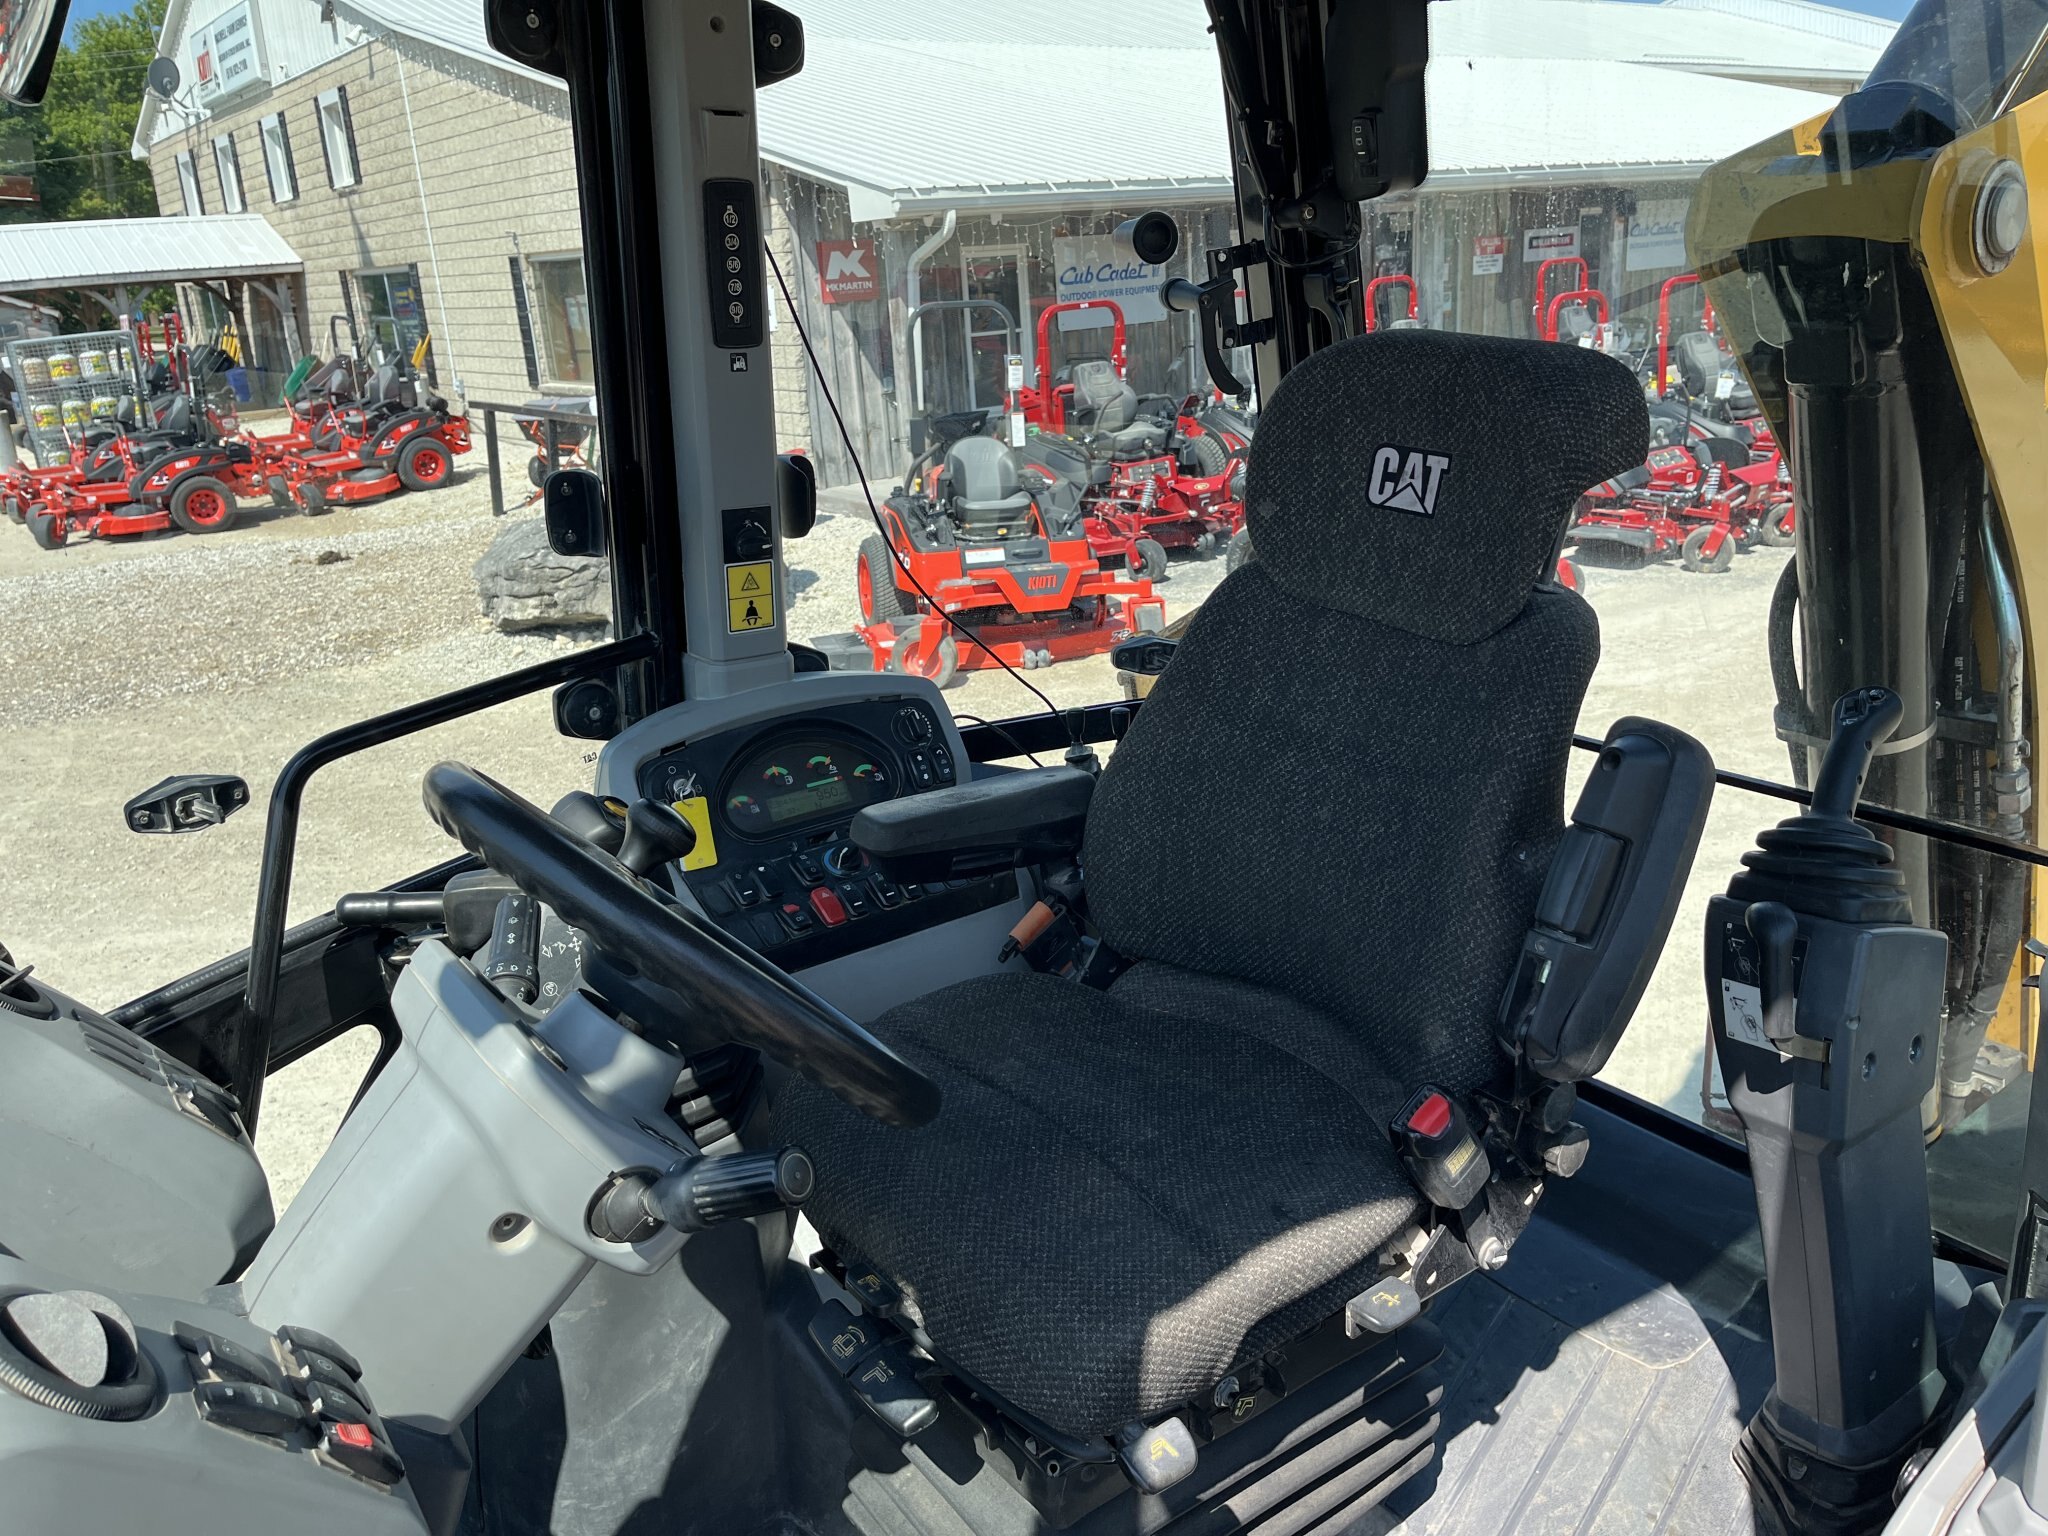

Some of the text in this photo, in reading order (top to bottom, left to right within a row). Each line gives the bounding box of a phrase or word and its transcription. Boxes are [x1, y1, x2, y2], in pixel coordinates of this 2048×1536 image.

[725, 214, 736, 224] 1/2
[727, 237, 738, 247] 3/4
[728, 260, 739, 270] 5/6
[1060, 262, 1149, 285] Cub Cadet
[730, 283, 741, 292] 7/8
[1060, 284, 1160, 302] OUTDOOR POWER EQUIPMEN
[1368, 446, 1450, 515] CAT
[1028, 574, 1057, 590] KIOTI
